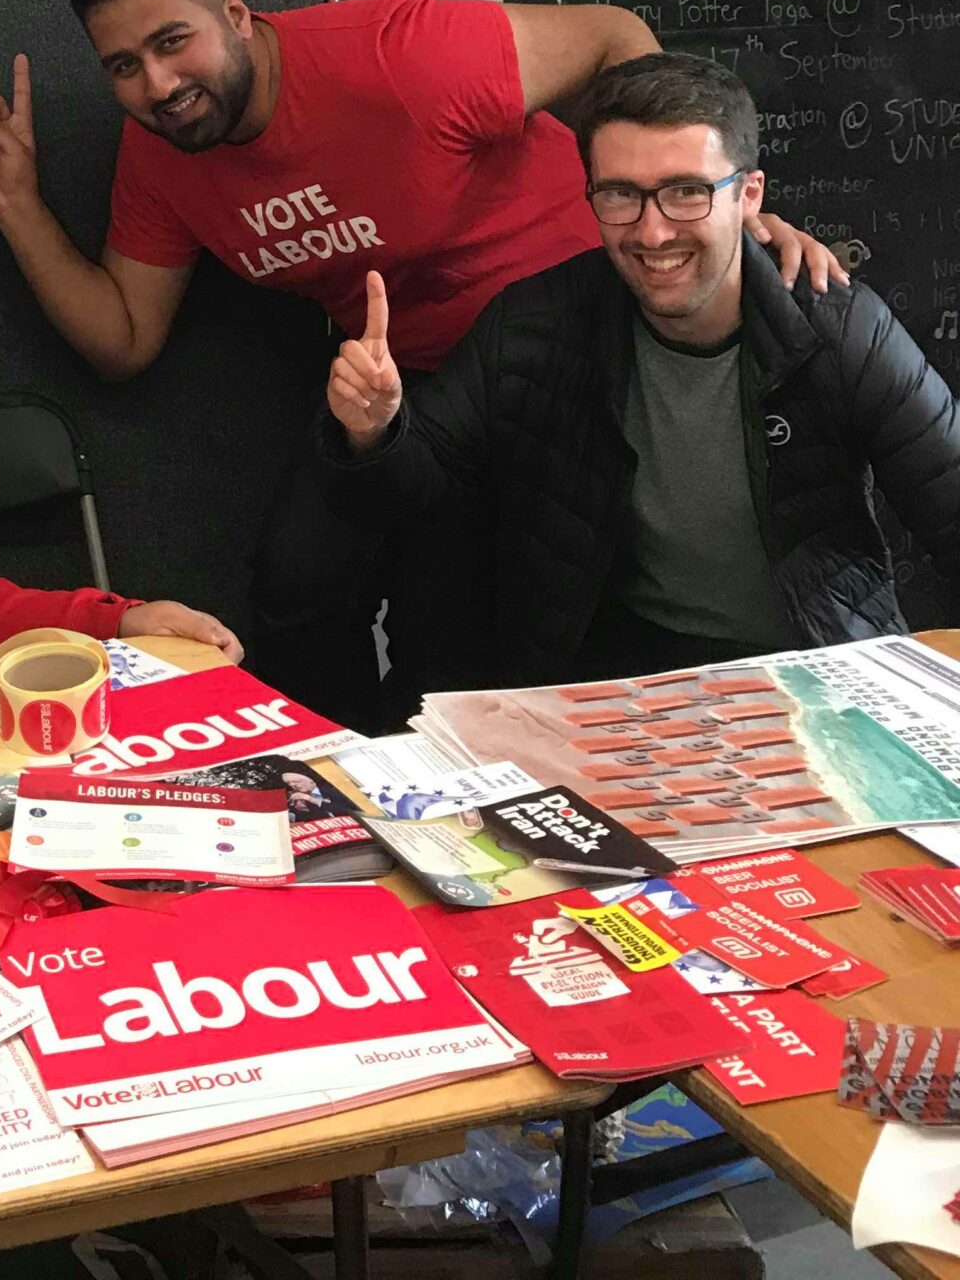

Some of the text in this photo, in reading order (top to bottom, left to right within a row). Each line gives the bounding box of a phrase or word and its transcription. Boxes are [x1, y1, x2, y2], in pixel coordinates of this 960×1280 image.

[756, 101, 827, 131] eration
[239, 183, 338, 238] VOTE
[237, 215, 387, 278] LABOUR
[71, 698, 300, 778] abour
[77, 784, 227, 805] LABOUR'S PLEDGES:
[494, 804, 547, 843] Iran
[517, 801, 601, 855] Attack
[539, 793, 611, 840] Don't
[294, 830, 346, 852] NOT THE
[713, 870, 756, 885] BEER
[725, 873, 801, 895] SOCIALIST
[706, 910, 791, 958] SOCIALIST
[718, 906, 763, 932] BEER
[7, 942, 107, 978] Vote
[22, 946, 429, 1056] Labour
[570, 989, 603, 1000] GUIDE
[729, 993, 816, 1057] A PART
[62, 1034, 494, 1112] Vote Labour labour.org.uk
[8, 1139, 31, 1151] join
